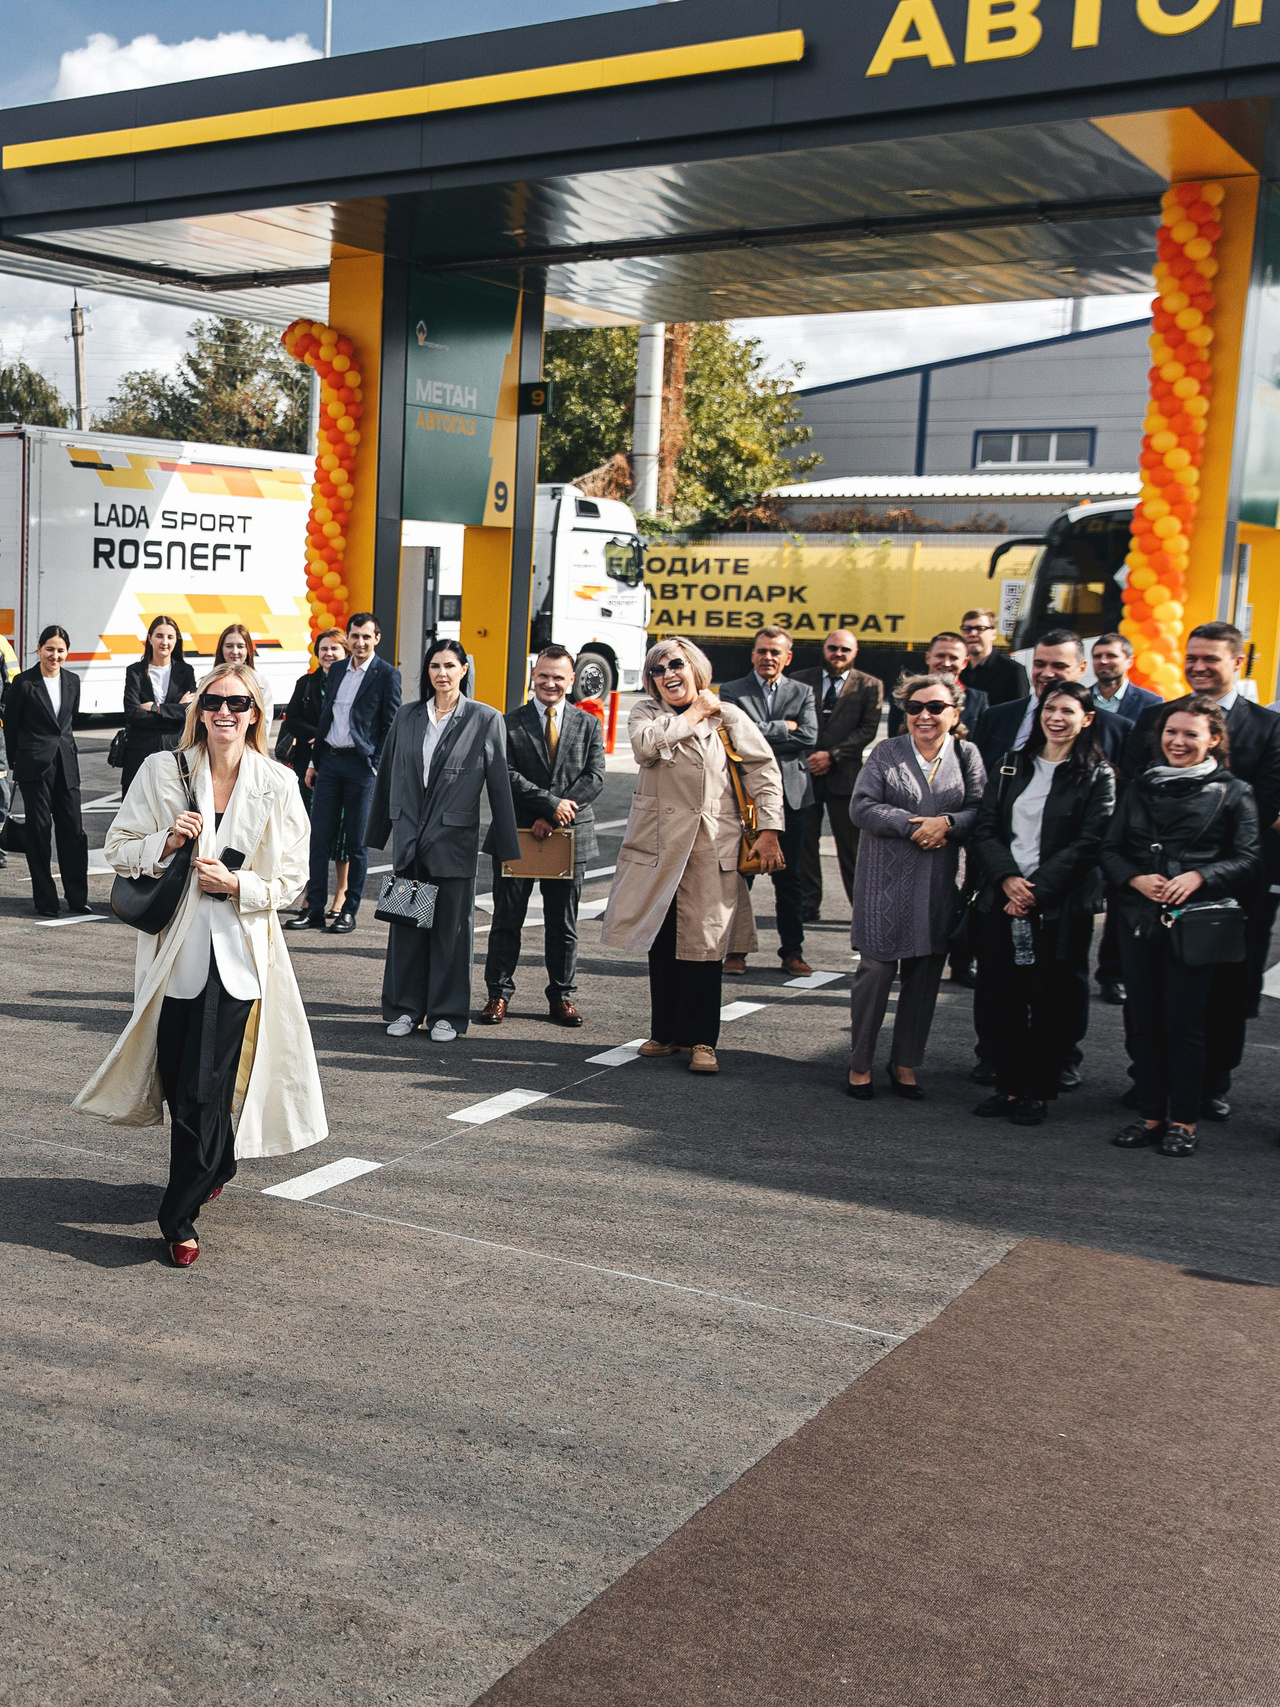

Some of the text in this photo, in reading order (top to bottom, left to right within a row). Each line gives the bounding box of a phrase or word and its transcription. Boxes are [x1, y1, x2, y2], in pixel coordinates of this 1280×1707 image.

[416, 379, 478, 410] МЕТАН
[531, 390, 545, 406] 9
[416, 411, 476, 436] АВТОГАЗ
[493, 481, 508, 512] 9
[94, 502, 252, 533] LADA SPORT
[93, 537, 252, 572] ROSNEFT
[651, 609, 905, 633] АН БЕЗ ЗАТРАТ
